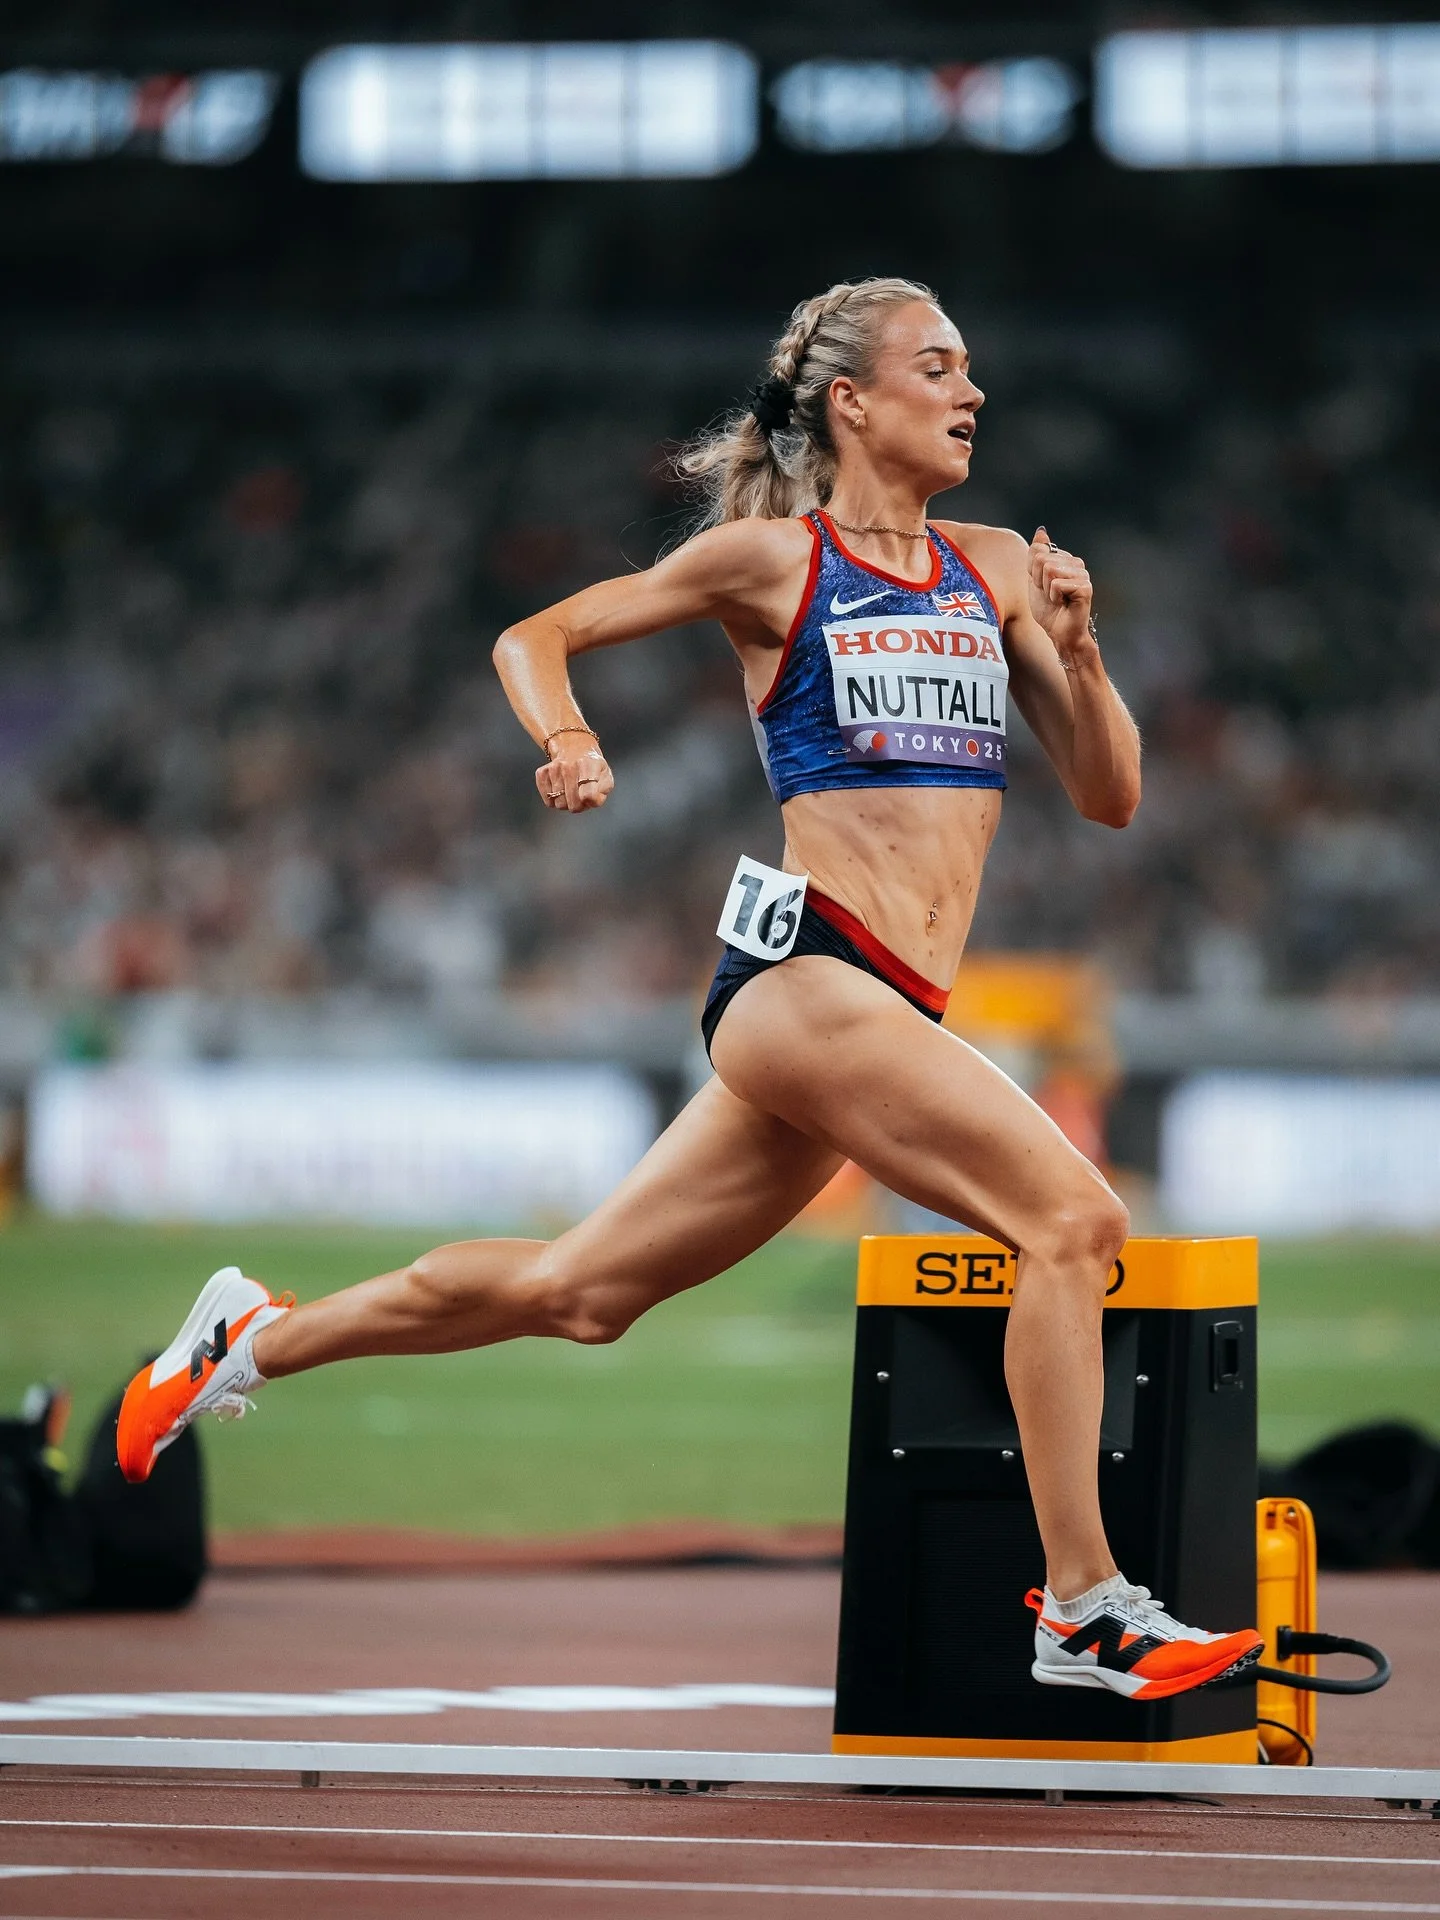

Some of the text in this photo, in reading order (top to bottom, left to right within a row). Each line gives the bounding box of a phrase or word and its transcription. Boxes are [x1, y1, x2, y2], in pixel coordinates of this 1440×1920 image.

[830, 628, 1003, 664] HONDA
[846, 675, 1001, 729] NUTTALL
[732, 872, 804, 950] 16
